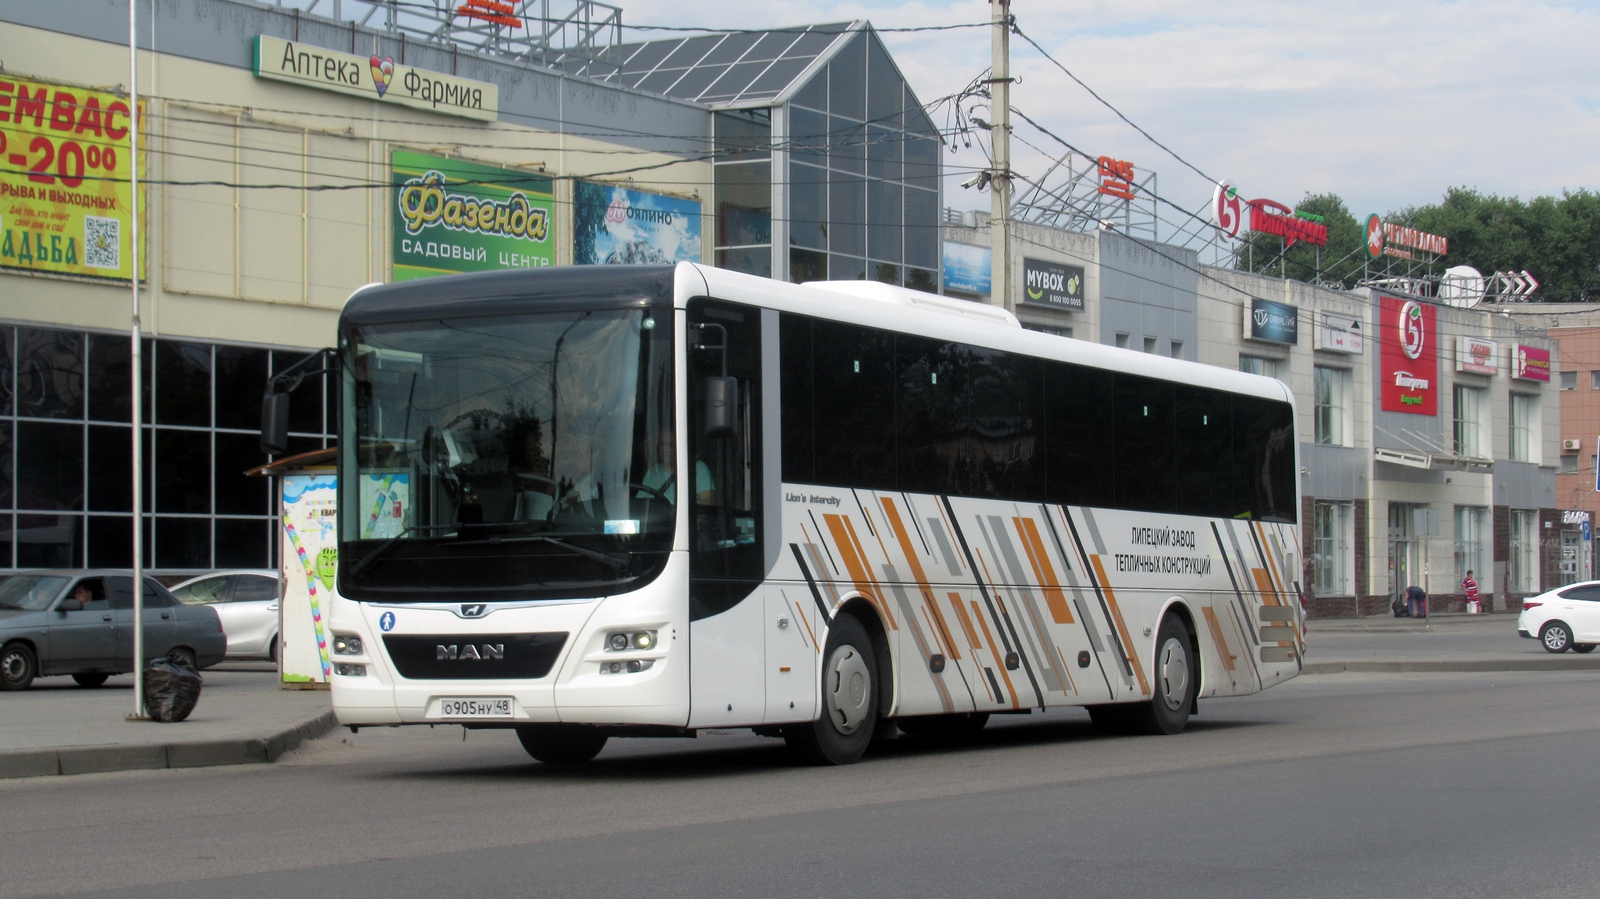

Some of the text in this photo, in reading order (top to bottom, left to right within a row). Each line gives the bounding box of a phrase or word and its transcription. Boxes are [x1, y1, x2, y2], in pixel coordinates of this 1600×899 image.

[281, 41, 482, 109] Аптека Фармия
[1098, 155, 1134, 182] DNS
[1, 182, 116, 210] РЫВА И ВЫХОДНЫХ
[400, 171, 548, 241] Фазенда
[402, 239, 549, 267] САДОВЫЙ ЦЕНТР
[1027, 269, 1064, 292] MYBOX
[785, 492, 841, 508] Lion's Intercity
[1132, 525, 1195, 551] ЛИПЕЦКИЙ ЗАВОД
[1115, 554, 1211, 578] ТЕПЛИЧНЫХ КОНСТРУКЦИЙ
[436, 644, 504, 660] MAN
[495, 700, 509, 711] 48
